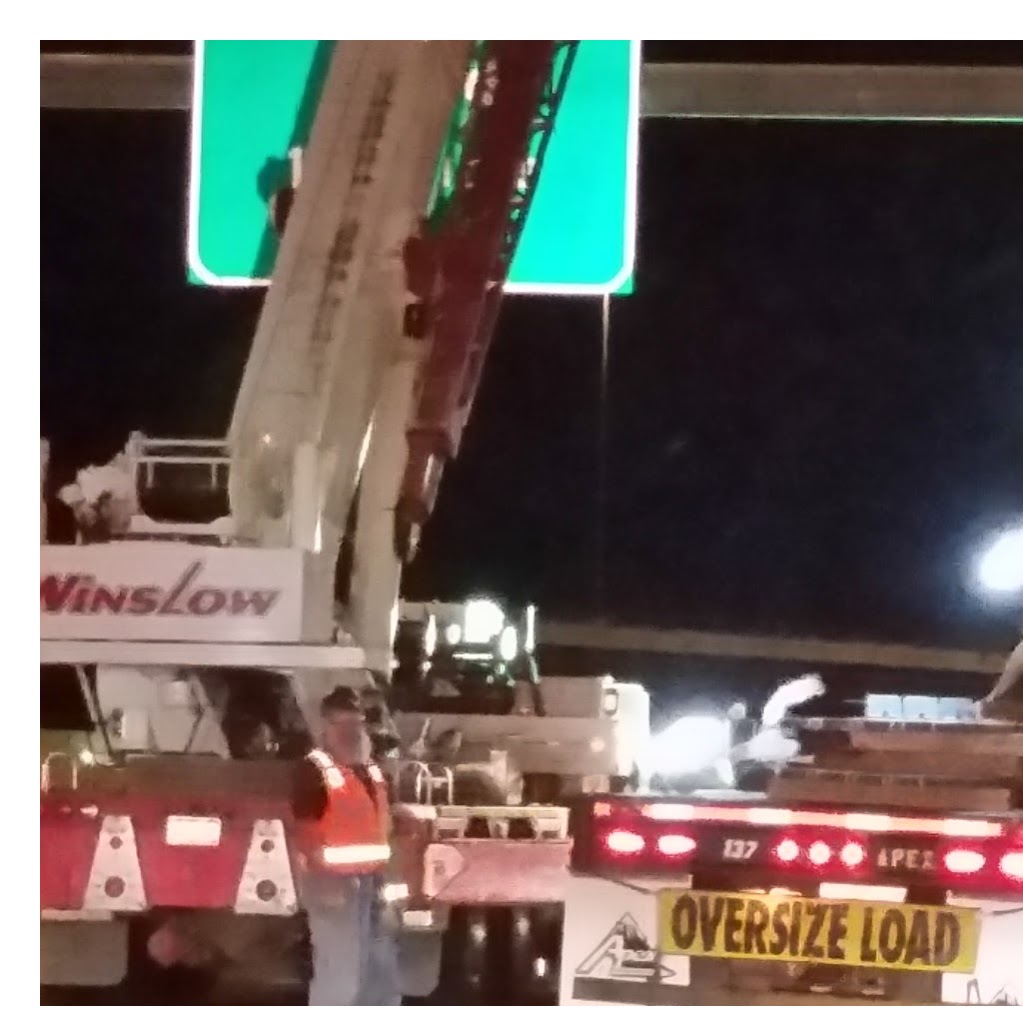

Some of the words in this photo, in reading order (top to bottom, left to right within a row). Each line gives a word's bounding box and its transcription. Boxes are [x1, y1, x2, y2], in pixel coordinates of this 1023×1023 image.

[723, 838, 758, 859] 137
[671, 893, 848, 960] OVERSIZE
[860, 906, 960, 965] LOAD
